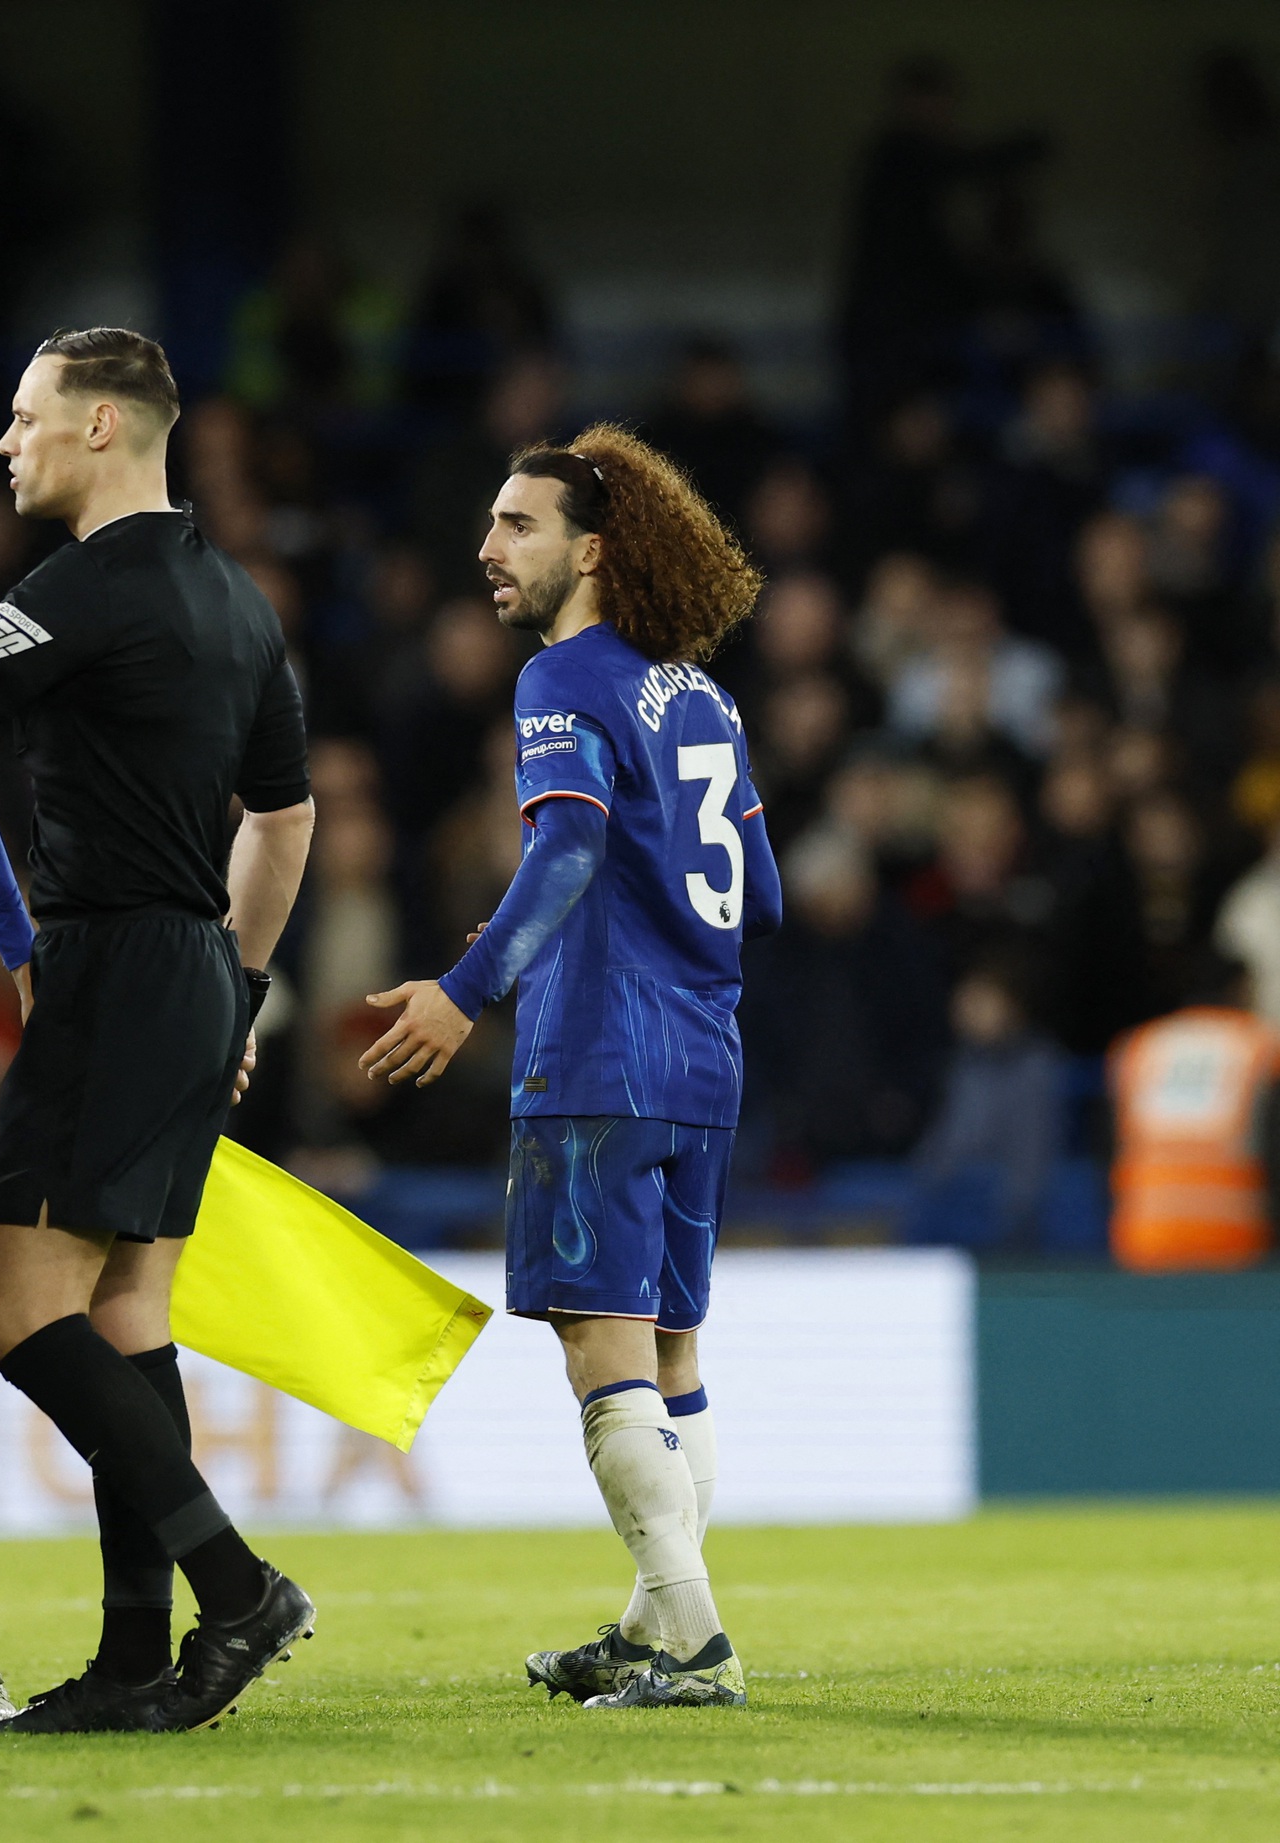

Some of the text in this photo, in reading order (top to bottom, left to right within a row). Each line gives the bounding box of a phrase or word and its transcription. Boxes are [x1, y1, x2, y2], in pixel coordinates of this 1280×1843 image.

[9, 609, 42, 637] SPORTS
[519, 713, 577, 738] ever
[677, 743, 744, 930] 3
